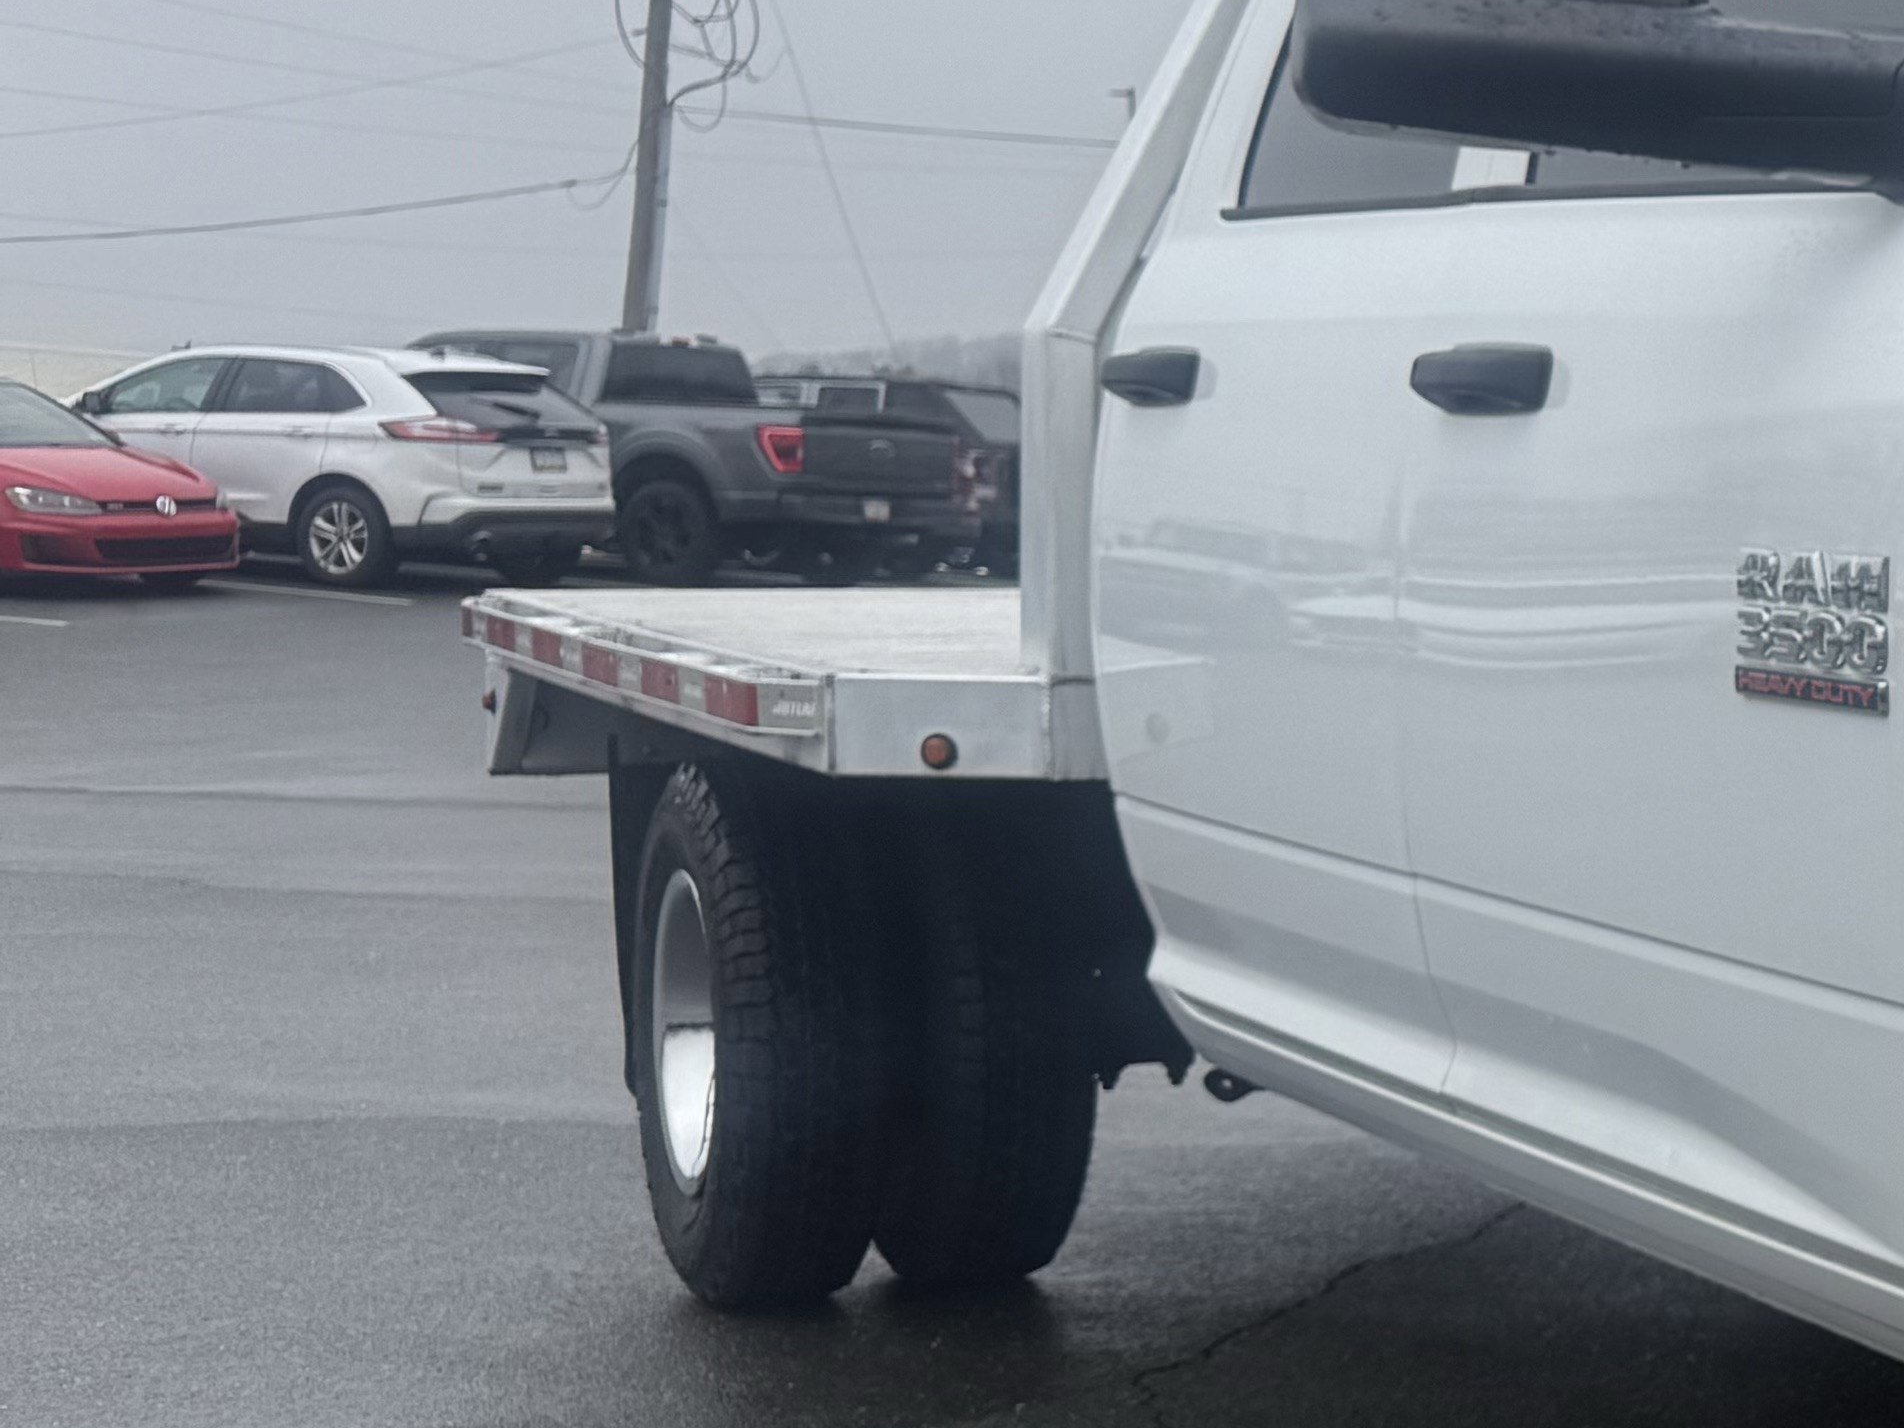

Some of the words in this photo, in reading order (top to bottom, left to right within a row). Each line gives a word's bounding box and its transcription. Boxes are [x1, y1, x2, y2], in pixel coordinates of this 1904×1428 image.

[1737, 548, 1889, 613] RAM
[1737, 605, 1888, 675] 3500
[1738, 670, 1809, 698] HEAVY
[1811, 679, 1876, 709] DUTY
